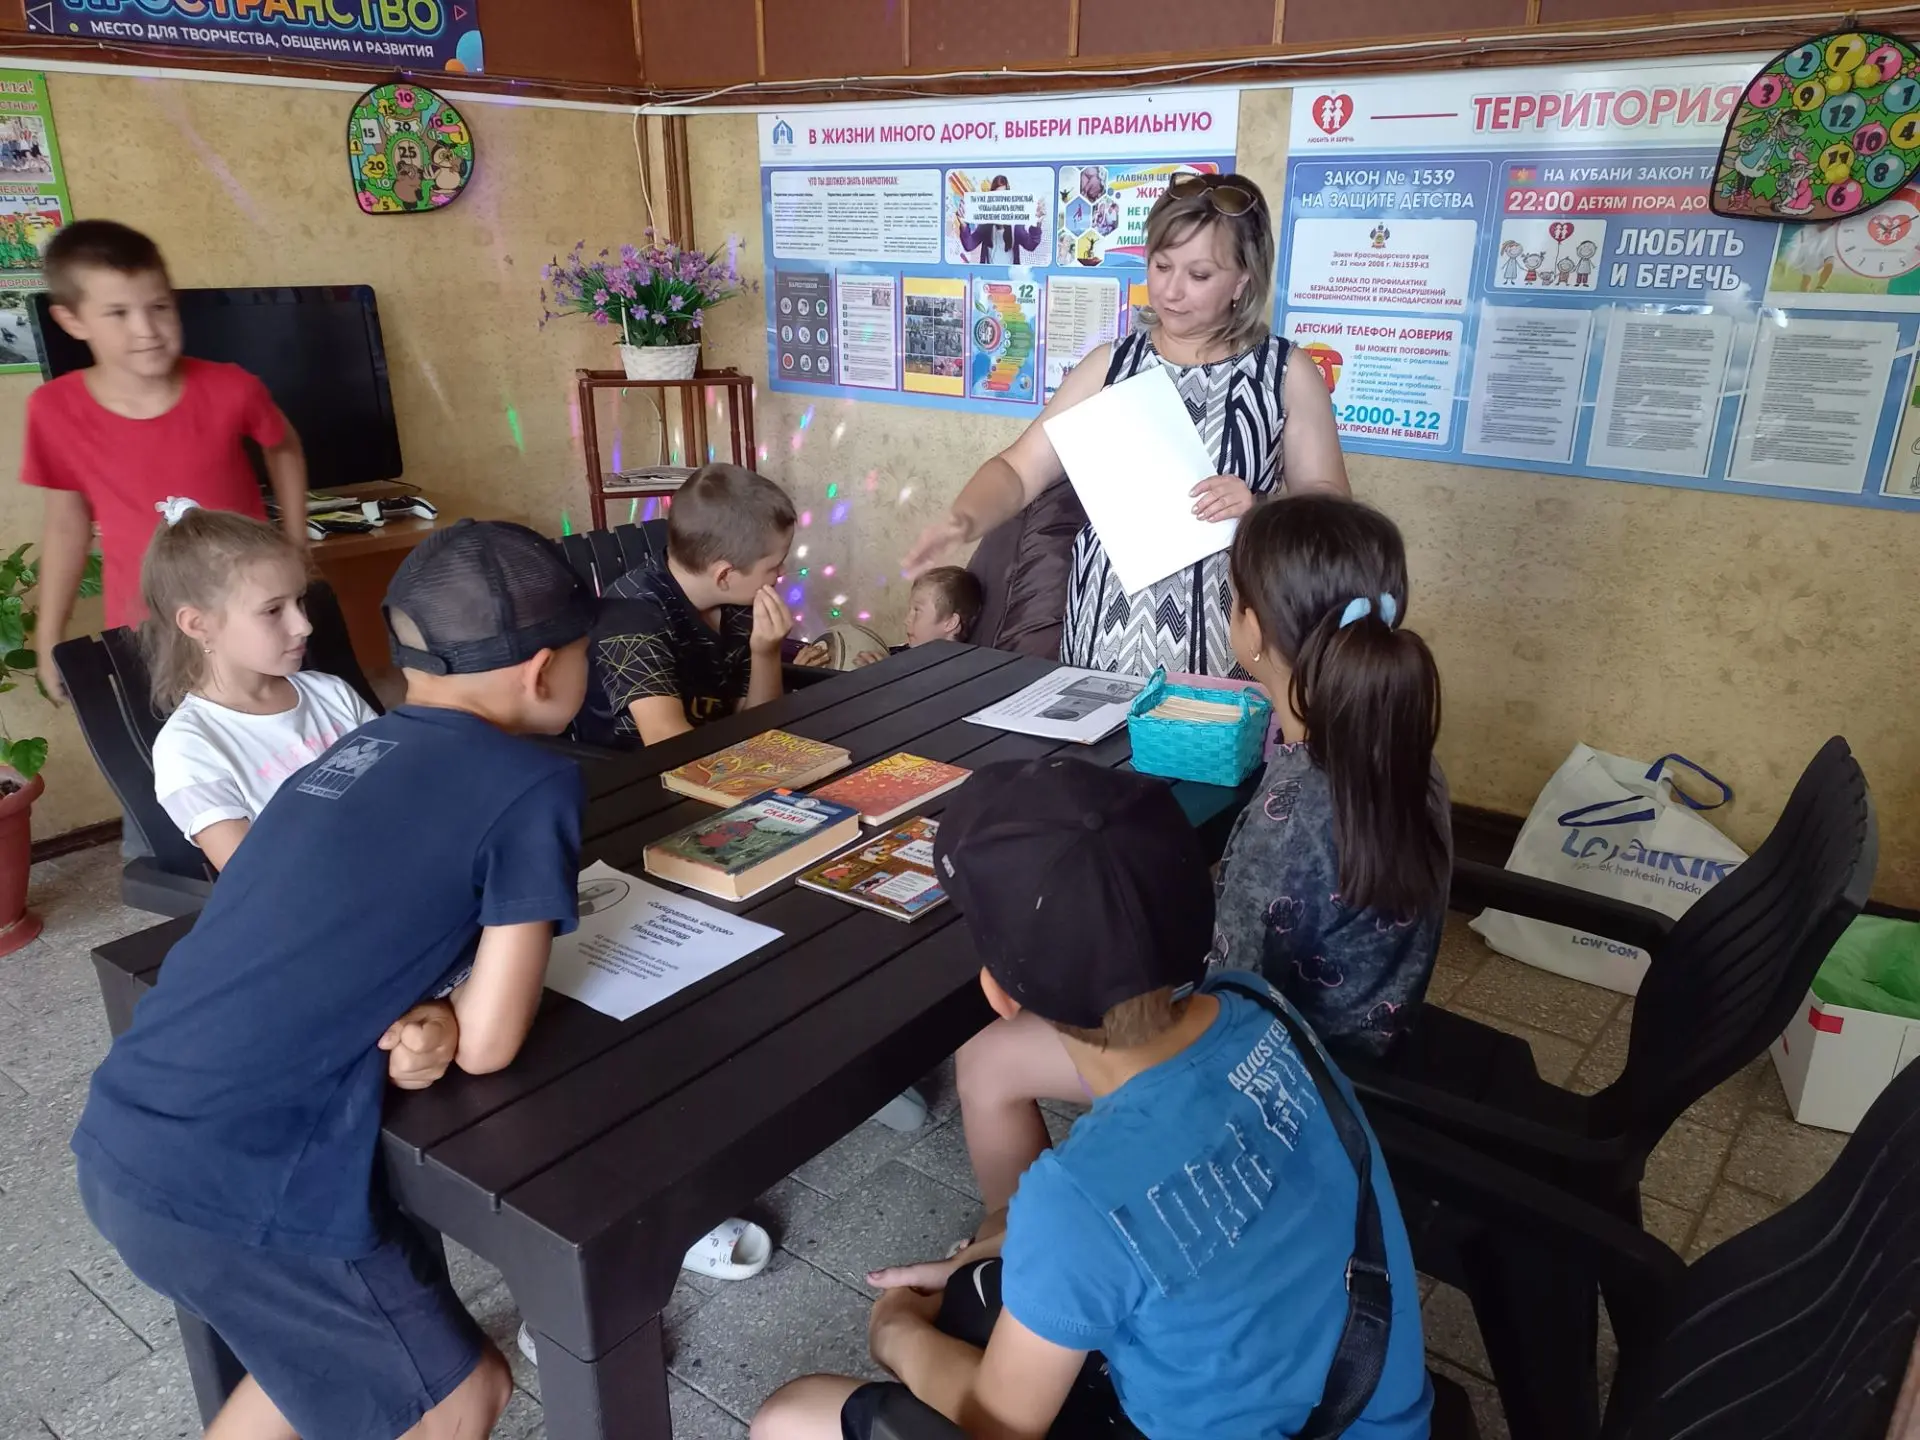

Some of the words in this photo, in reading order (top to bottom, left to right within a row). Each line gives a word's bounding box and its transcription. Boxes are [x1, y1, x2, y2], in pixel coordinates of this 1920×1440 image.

[90, 21, 143, 36] МЕСТО
[147, 25, 178, 40] ДЛЯ
[181, 27, 279, 48] ТВОРЧЕСТВА,
[281, 35, 350, 52] ОБЩЕНИЯ
[353, 39, 363, 53] И
[366, 41, 435, 58] РАЗВИТИЯ
[1799, 51, 1814, 73] 2
[1832, 47, 1849, 67] 7
[399, 92, 412, 103] 10
[1760, 84, 1774, 104] 3
[1800, 86, 1815, 107] 9
[1903, 84, 1915, 106] 1
[383, 104, 395, 115] 15
[1474, 86, 1743, 130] ТЕРРИТОРИЯ
[1829, 105, 1856, 128] 12
[394, 121, 411, 132] 20
[446, 113, 454, 123] 5
[363, 128, 375, 138] 15
[808, 128, 817, 145] В
[822, 126, 875, 145] ЖИЗНИ
[880, 123, 936, 143] МНОГО
[941, 121, 999, 143] ДОРОГ,
[1005, 118, 1071, 138] ВЫБЕРИ
[1078, 111, 1212, 135] ПРАВИЛЬНУЮ
[1898, 121, 1917, 141] 4
[1855, 131, 1883, 150] 10
[398, 146, 417, 159] 25
[367, 161, 385, 171] 20
[1544, 167, 1565, 182] НА
[1570, 167, 1633, 181] КУБАНИ
[1637, 166, 1694, 181] ЗАКОН
[1873, 163, 1889, 183] 8
[1116, 173, 1154, 182] ГЛАВНАЯ
[1324, 170, 1380, 186] ЗАКОН
[1385, 170, 1405, 185] №
[1412, 169, 1455, 185] 1539
[1136, 187, 1165, 199] ЖИЗ
[1301, 193, 1324, 208] НА
[1329, 192, 1396, 210] ЗАЩИТЕ
[1400, 192, 1474, 210] ДЕТСТВА
[1508, 191, 1574, 211] 22:00
[1577, 196, 1627, 211] ДЕТЯМ
[1632, 195, 1677, 209] ПОРА
[1831, 187, 1846, 206] 6
[383, 201, 390, 210] 5
[1127, 206, 1141, 216] НЕ
[1615, 228, 1745, 258] ЛЮБИТЬ
[1372, 278, 1427, 286] ПРОФИЛАКТИКЕ
[1609, 263, 1627, 287] И
[1636, 264, 1740, 290] БЕРЕЧЬ
[1018, 284, 1034, 298] 12
[1294, 292, 1371, 302] НЕСОВЕРШЕННОЛЕТНИХ
[1379, 296, 1443, 304] КРАСНОДАРСКОМ
[1310, 285, 1370, 293] БЕЗНАДЗОРНОСТИ
[1379, 287, 1446, 296] ПРАВОНАРУШЕНИЙ
[1294, 322, 1343, 335] ДЕТСКИЙ
[1346, 325, 1396, 338] ТЕЛЕФОН
[1399, 328, 1453, 341] ДОВЕРИЯ
[1368, 345, 1398, 353] МОЖЕТЕ
[1400, 347, 1451, 357] ПОГОВОРИТЬ:
[1350, 424, 1389, 435] ПРОБЛЕМ
[1391, 428, 1402, 436] НЕ
[1404, 429, 1439, 441] БЫВАЕТ!
[763, 808, 805, 825] СКАЗКИ
[1615, 865, 1665, 886] herkesin
[1227, 1018, 1288, 1091] ADJUSTED
